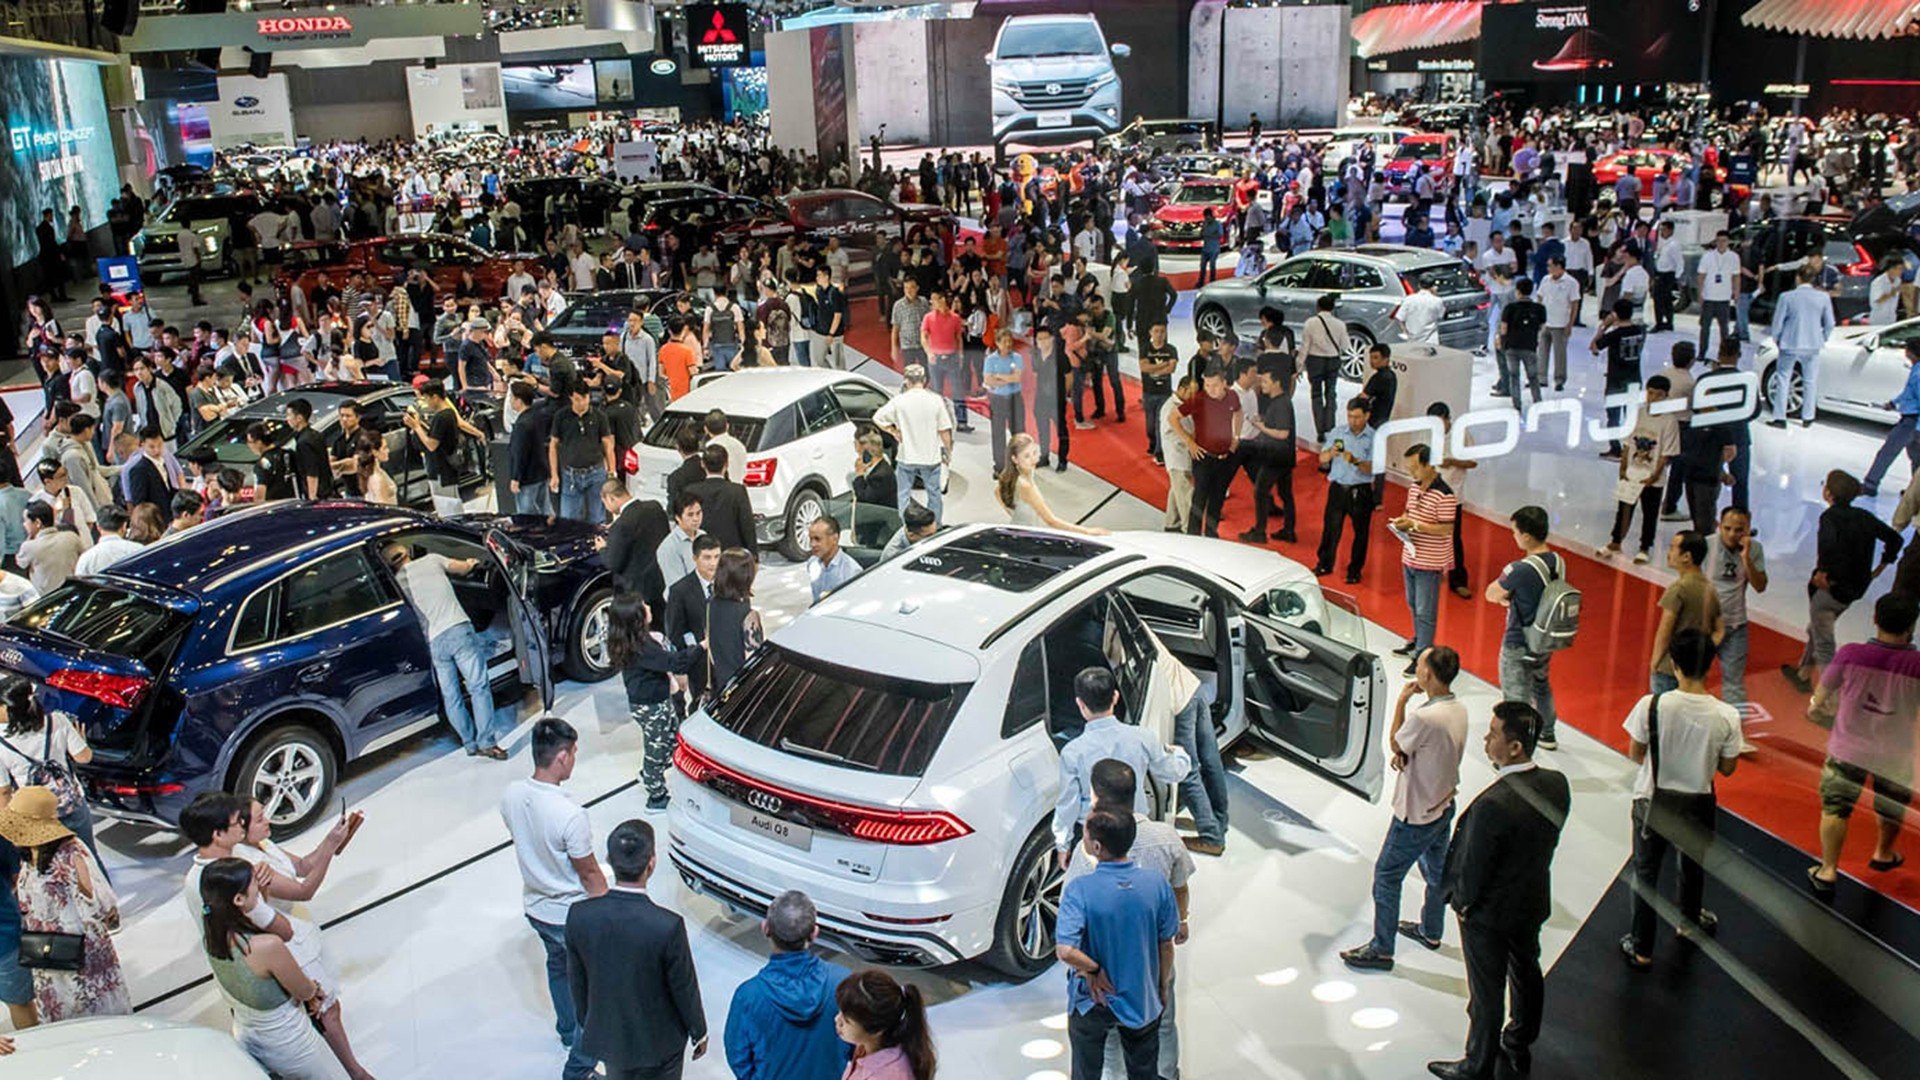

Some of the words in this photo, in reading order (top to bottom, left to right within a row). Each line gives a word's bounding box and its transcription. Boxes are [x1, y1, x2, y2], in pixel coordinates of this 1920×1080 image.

[257, 16, 353, 34] HONDA
[1535, 13, 1566, 31] Strong
[1566, 12, 1589, 27] DNA
[697, 43, 744, 54] MITSUBISHI
[704, 53, 738, 62] MOTORS
[10, 127, 31, 151] GT
[32, 130, 59, 146] PHEV
[751, 815, 773, 832] Audi
[774, 823, 789, 837] Q8
